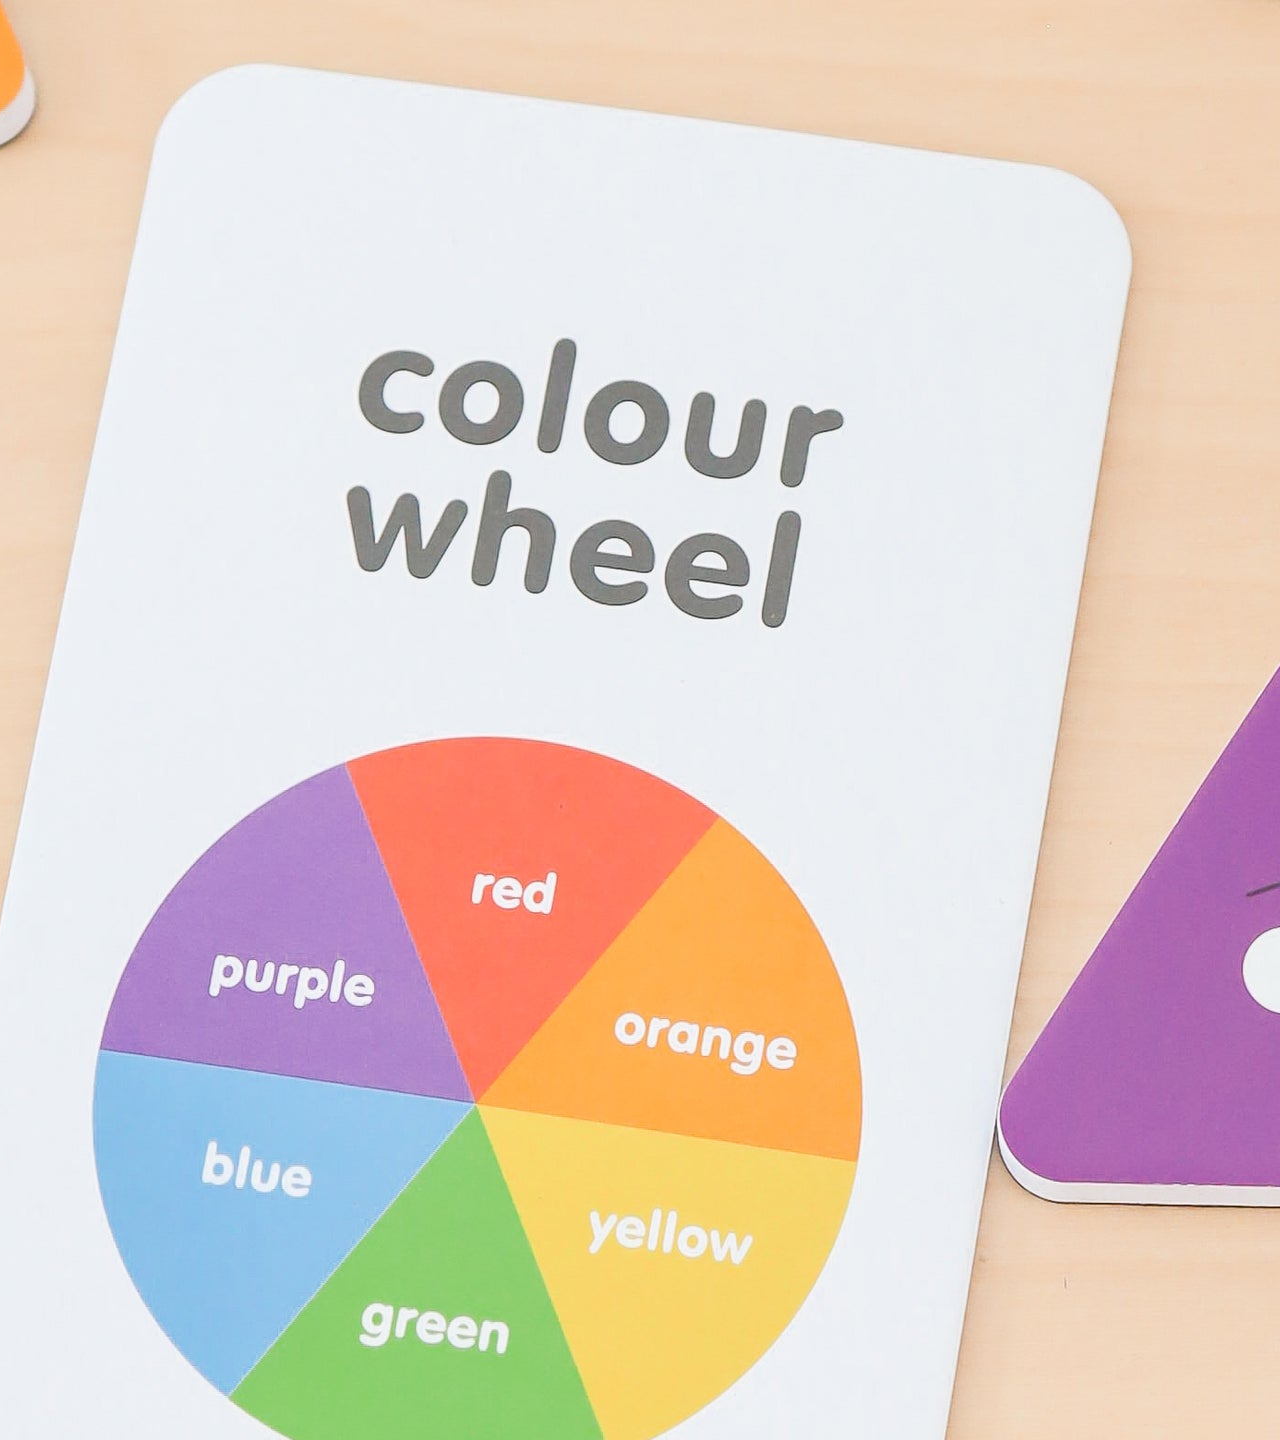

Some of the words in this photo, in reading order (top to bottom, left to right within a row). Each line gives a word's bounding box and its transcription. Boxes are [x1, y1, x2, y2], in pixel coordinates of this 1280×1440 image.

[357, 337, 845, 489] colour
[346, 469, 802, 629] wheel
[471, 871, 557, 915] red
[209, 954, 376, 1009] purple
[614, 1011, 798, 1076] orange
[201, 1140, 313, 1198] blue
[588, 1207, 754, 1266] yellow
[358, 1302, 510, 1356] green
